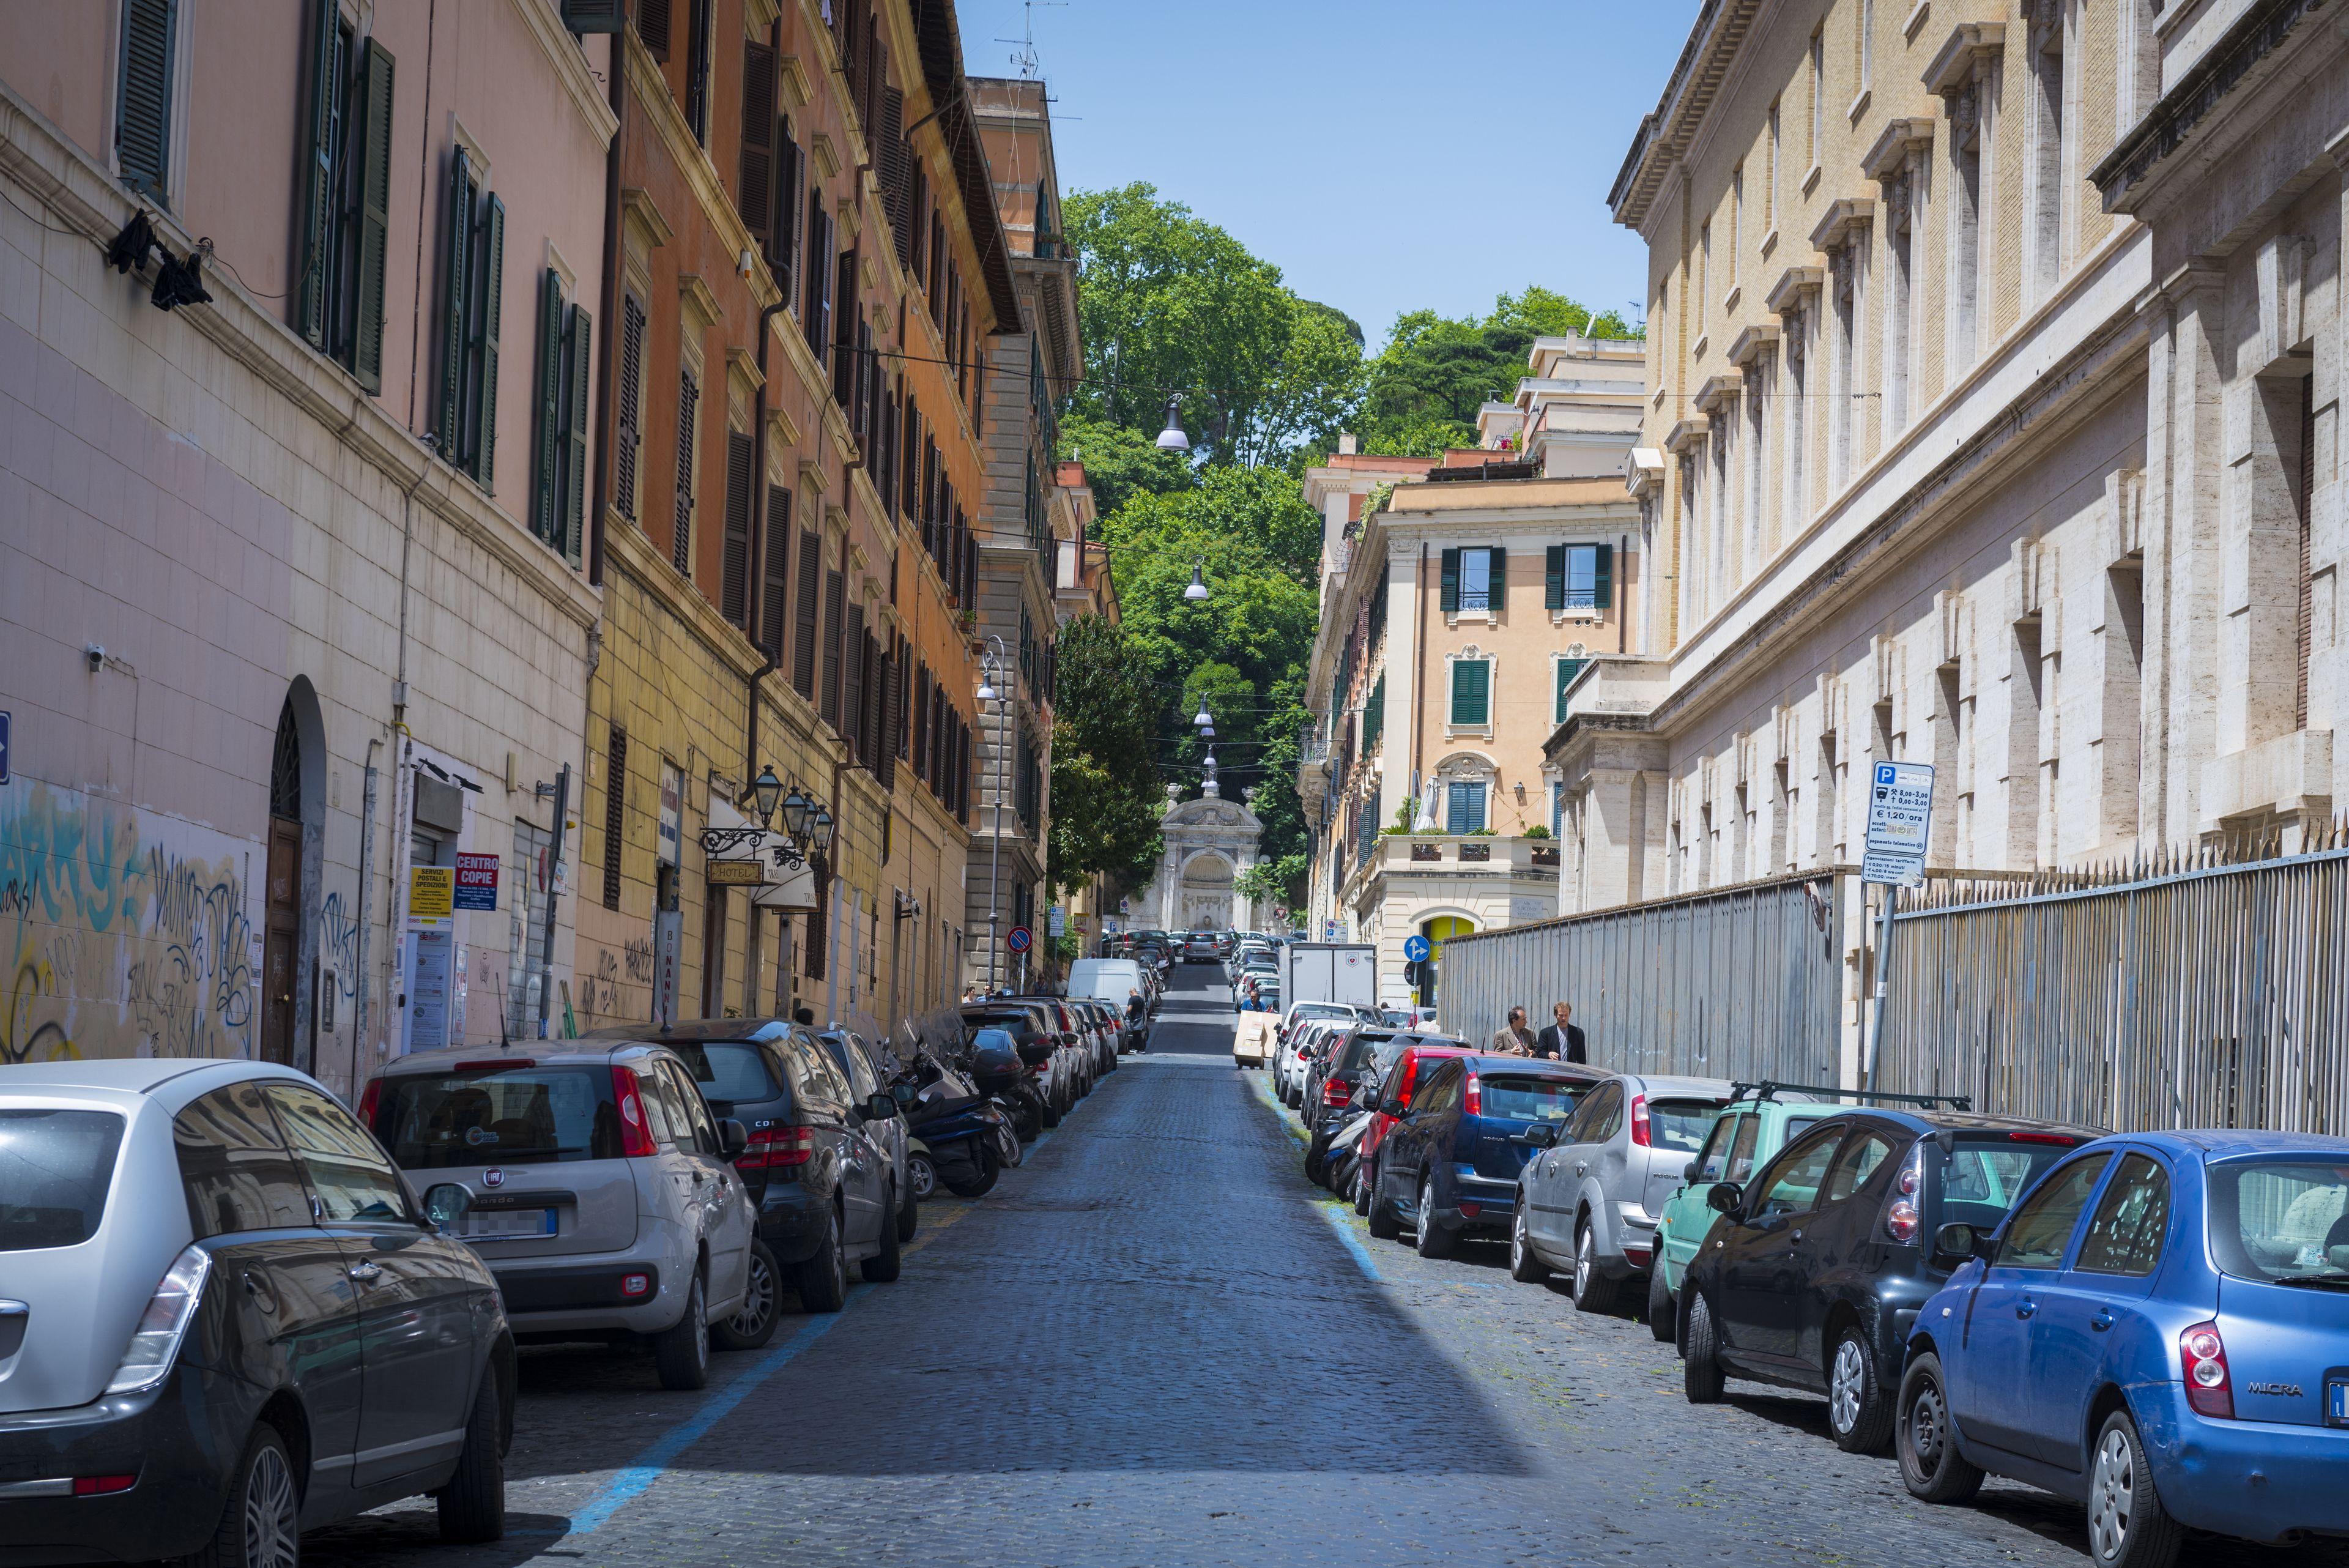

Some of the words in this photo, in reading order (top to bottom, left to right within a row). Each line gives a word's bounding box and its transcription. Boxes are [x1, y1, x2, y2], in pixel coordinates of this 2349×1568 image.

[1881, 768, 1893, 782] P
[457, 856, 499, 871] CENTRO
[461, 870, 492, 885] COPIE
[719, 868, 751, 877] HOTEL
[488, 1173, 500, 1181] FIAT
[2248, 1381, 2303, 1397] MICRA
